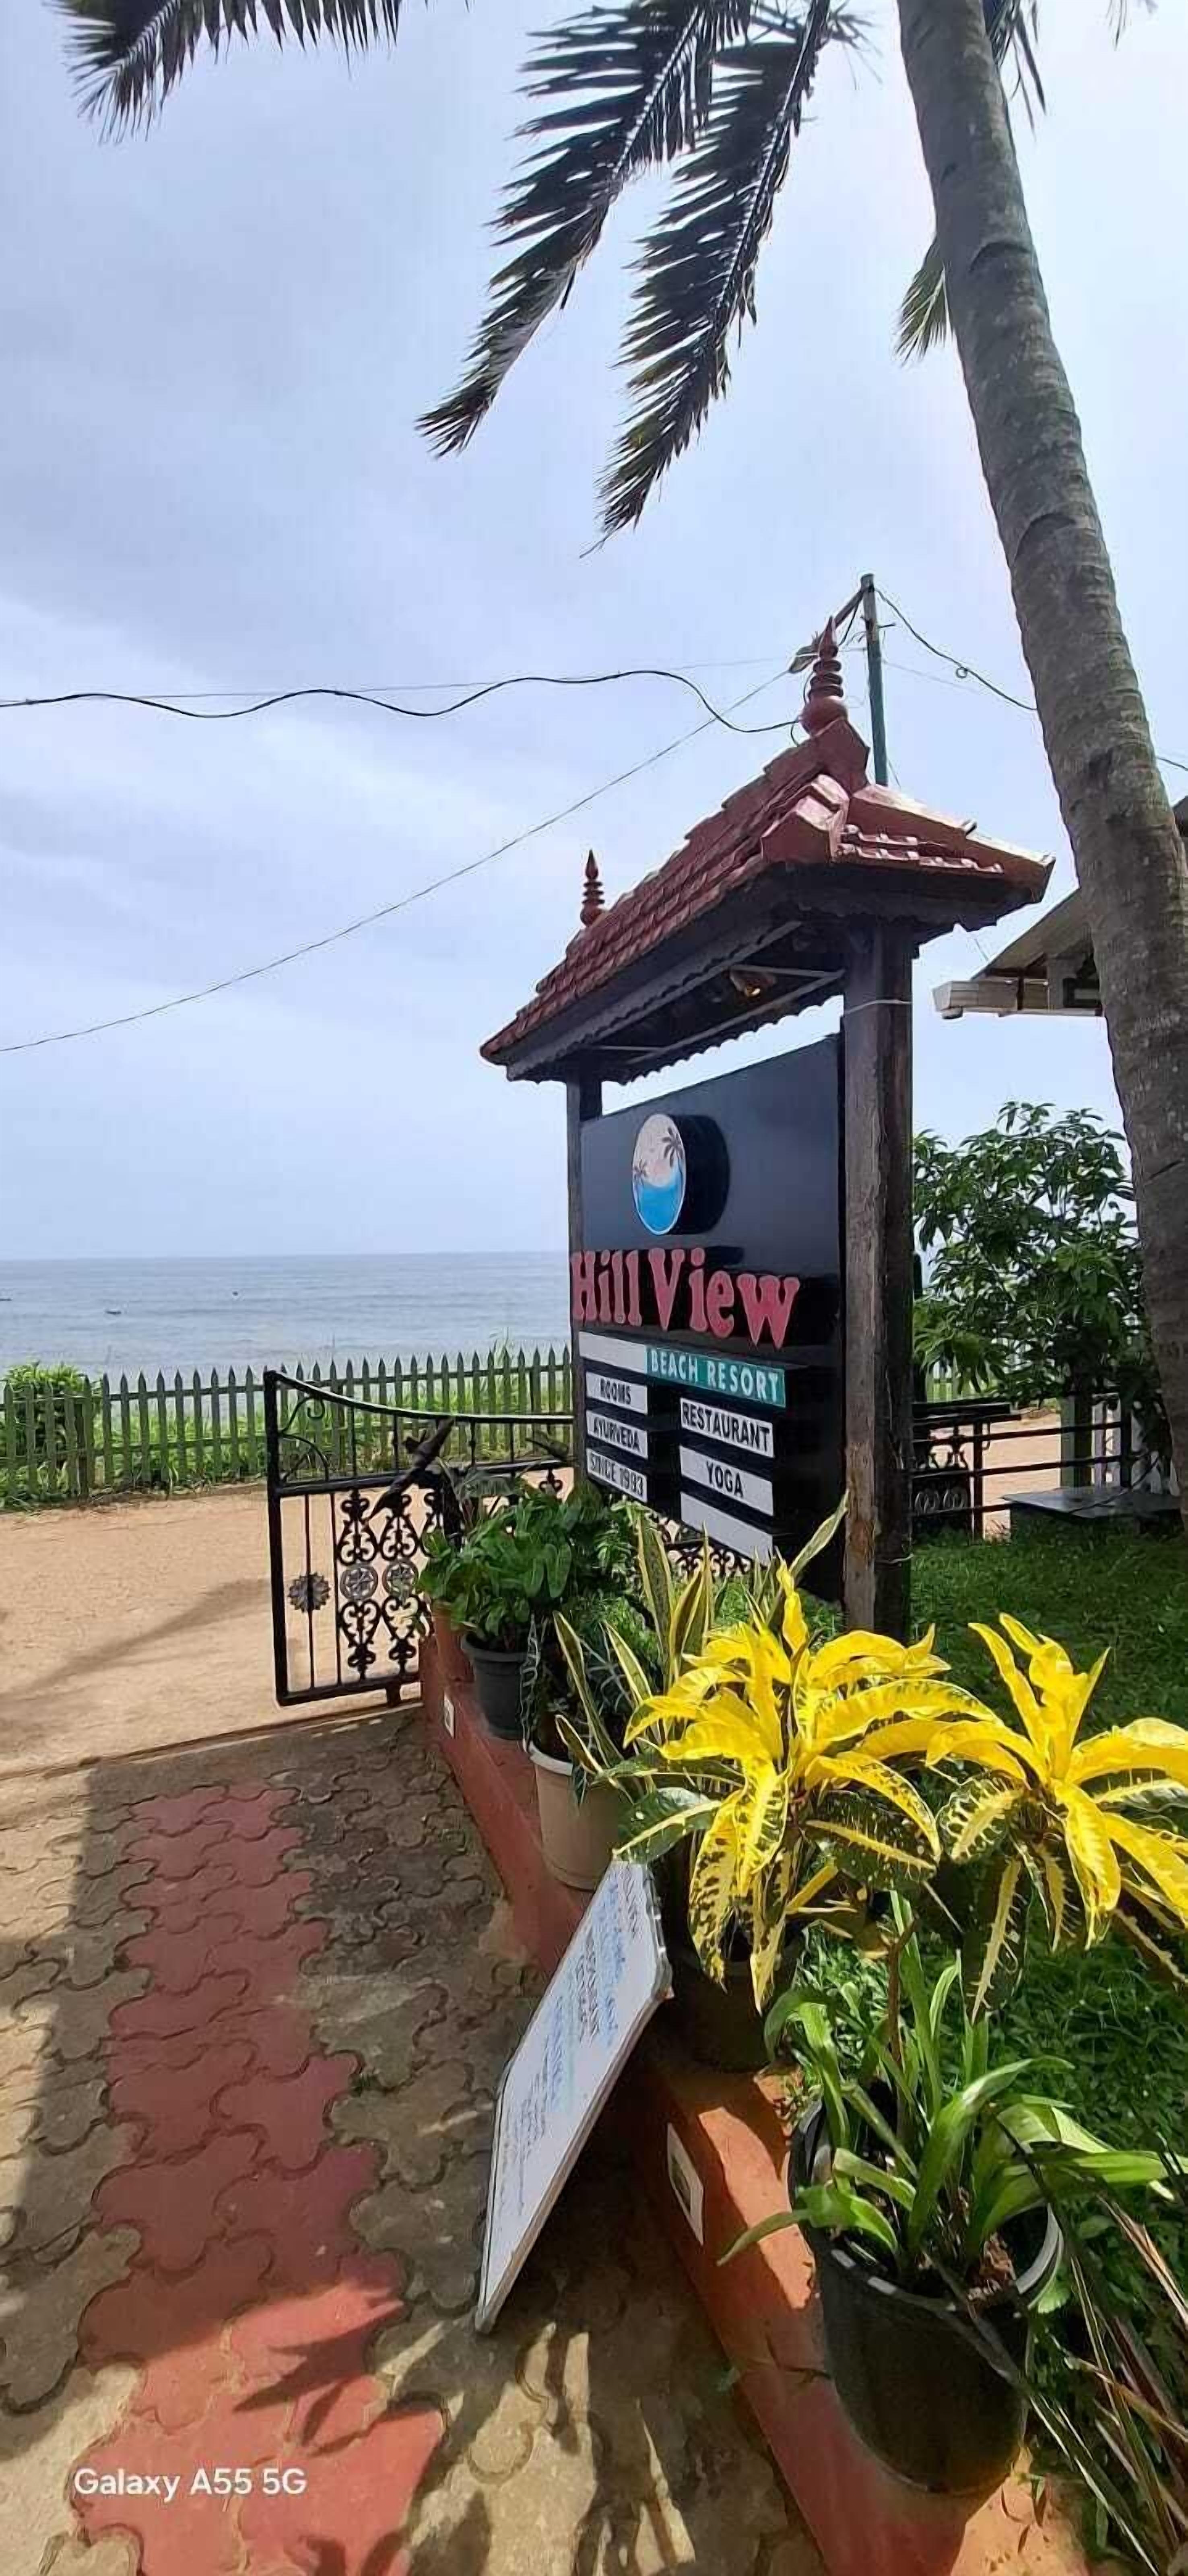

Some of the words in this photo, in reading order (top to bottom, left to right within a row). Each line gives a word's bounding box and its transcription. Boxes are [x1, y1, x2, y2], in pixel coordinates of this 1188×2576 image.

[571, 1249, 641, 1326] Hill
[648, 1248, 800, 1350] View
[600, 1378, 631, 1405] ROOMS
[650, 1348, 698, 1383] BEACH
[707, 1360, 779, 1401] RESORT
[593, 1416, 640, 1451] AYURVEDA
[682, 1403, 770, 1452] RESTAURANT
[591, 1453, 616, 1481] SINCE
[705, 1460, 745, 1499] YOGA
